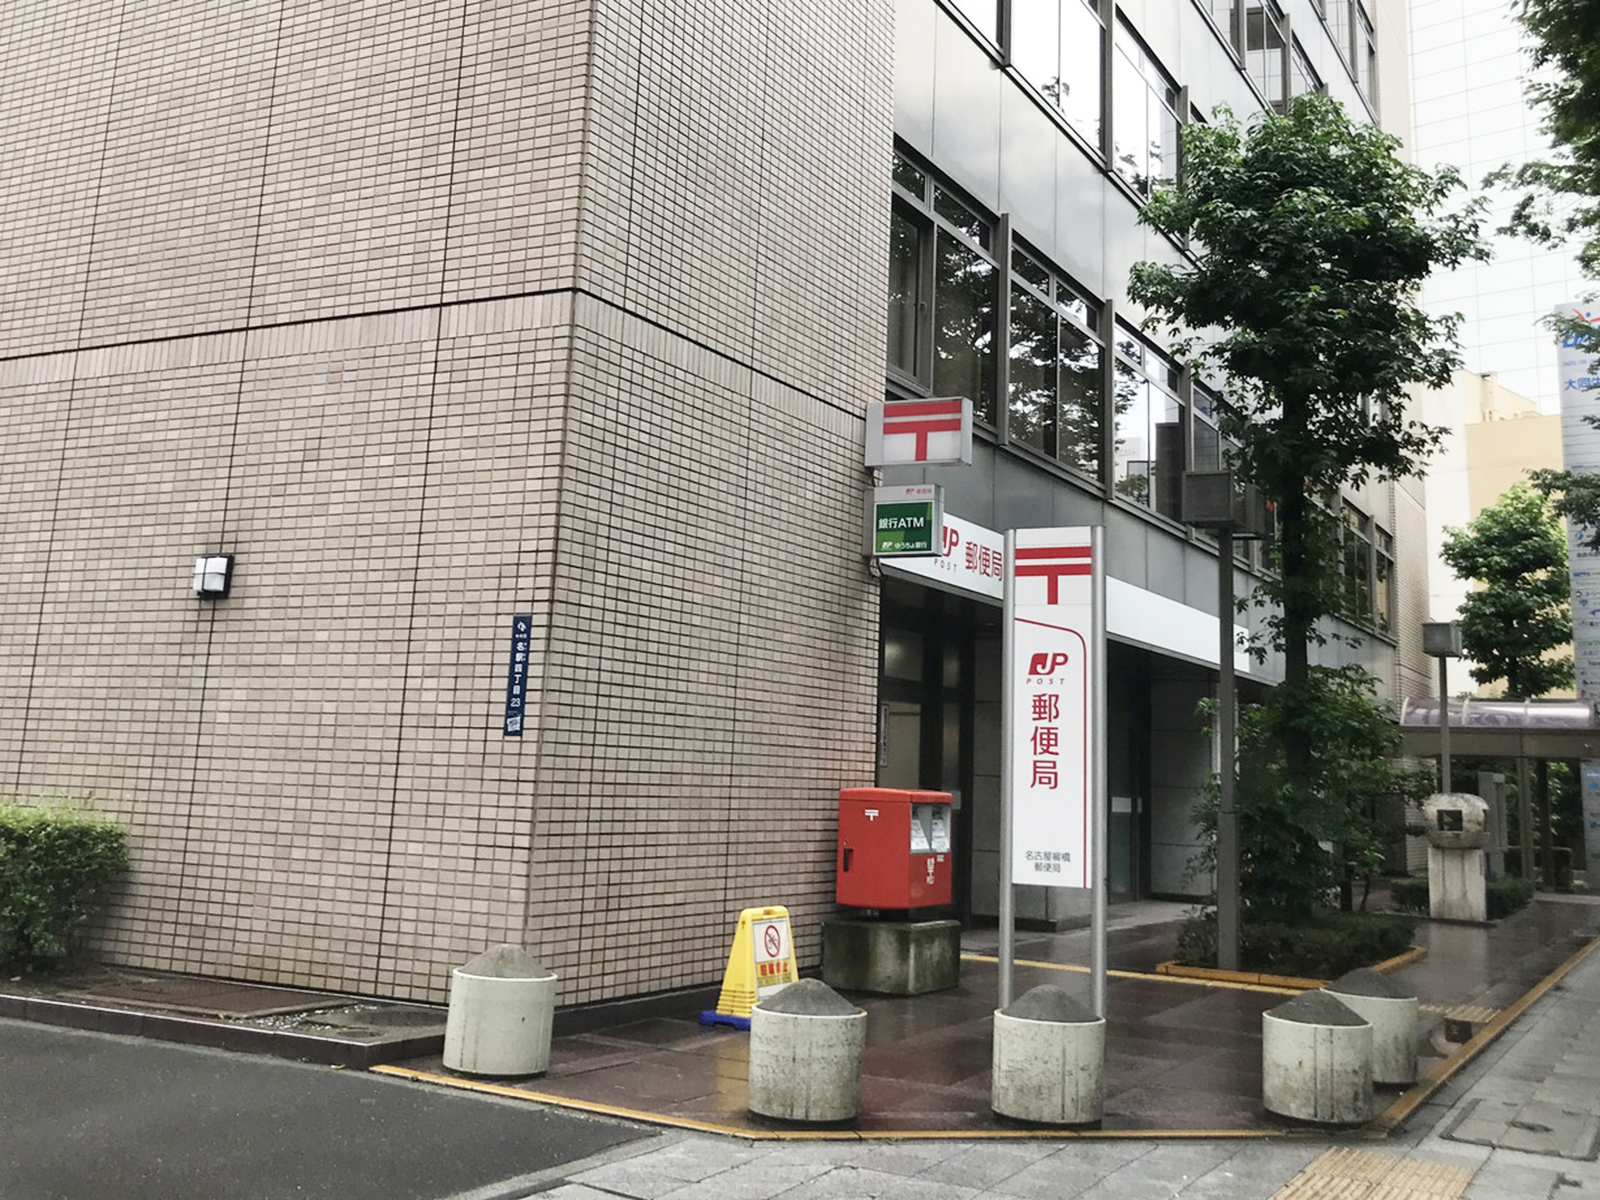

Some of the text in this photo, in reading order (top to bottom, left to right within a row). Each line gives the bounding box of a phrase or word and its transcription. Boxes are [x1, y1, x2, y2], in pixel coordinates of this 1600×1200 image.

[878, 517, 925, 529] 銀行ATM
[965, 541, 1003, 581] 郵便局
[510, 698, 520, 707] 23
[1030, 693, 1059, 790] 郵便局
